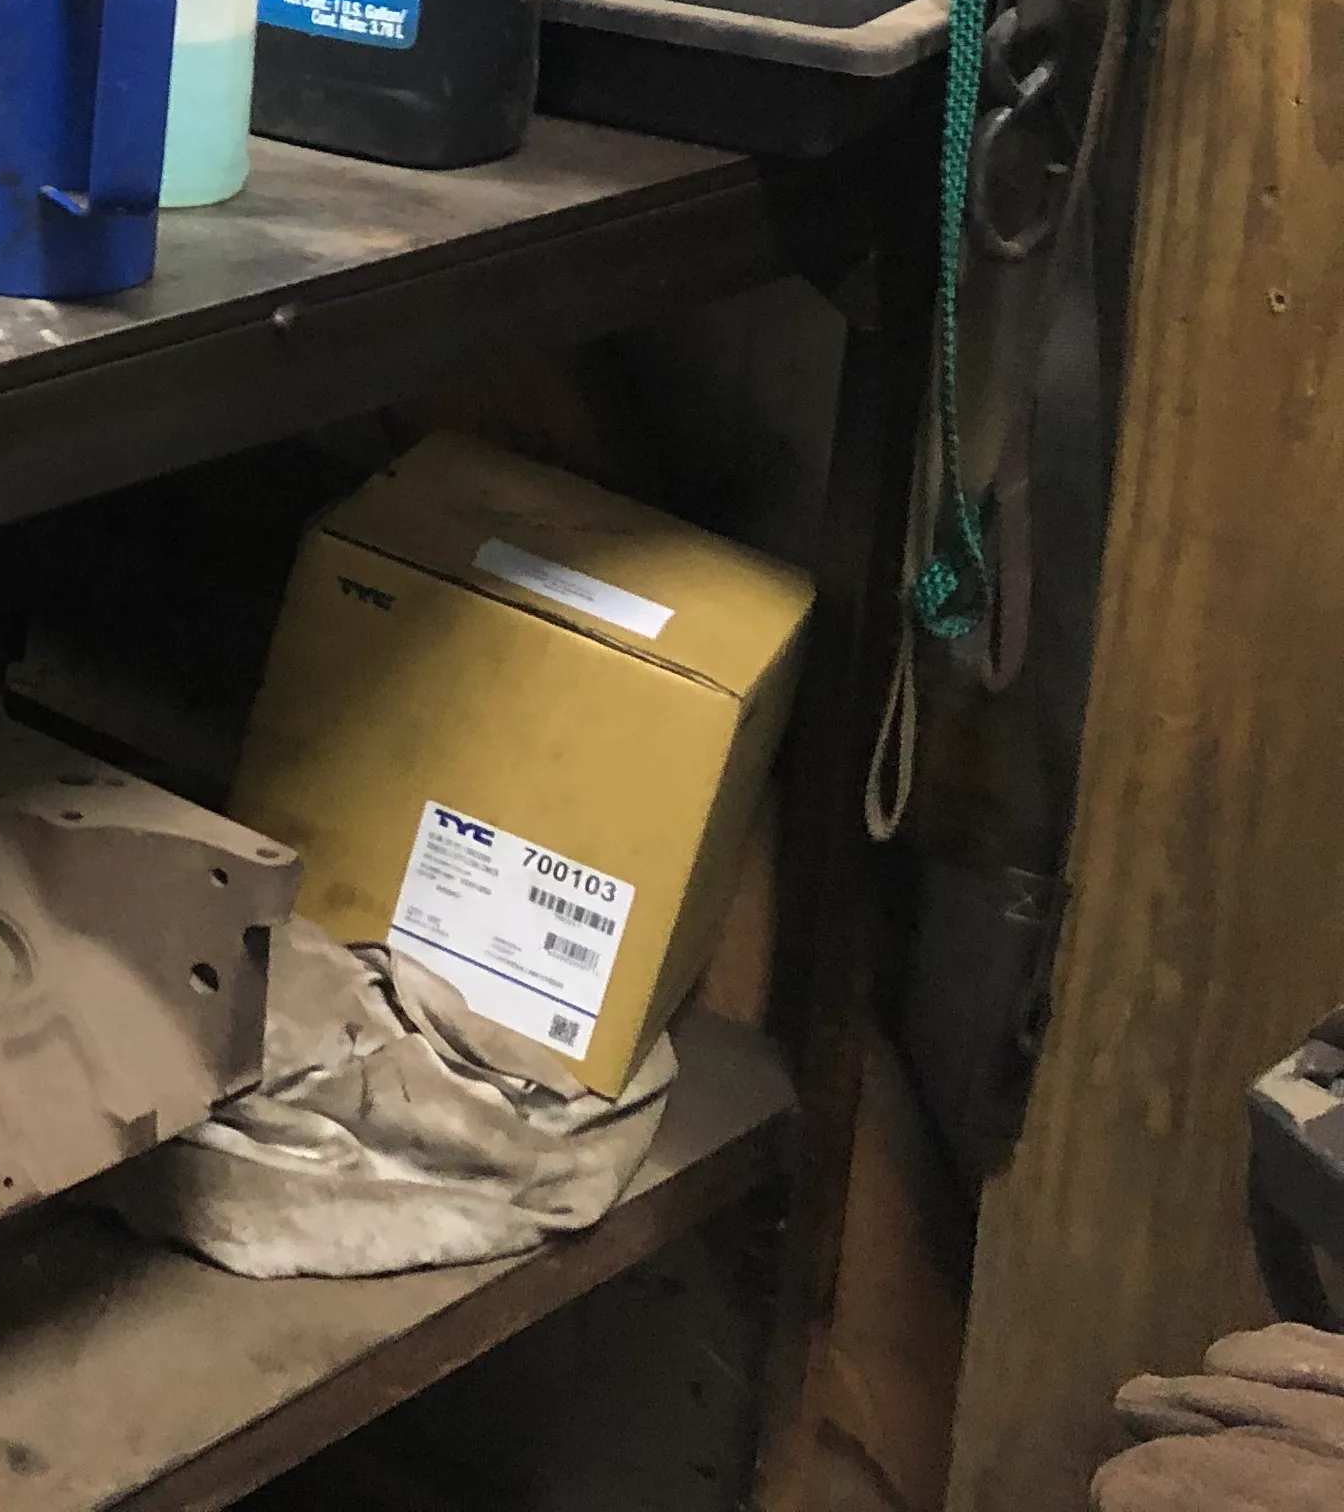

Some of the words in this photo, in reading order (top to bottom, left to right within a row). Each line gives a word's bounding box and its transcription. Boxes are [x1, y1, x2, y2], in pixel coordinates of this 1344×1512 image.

[341, 0, 364, 18] U.S.
[434, 808, 495, 848] TYC
[522, 846, 617, 903] 700103
